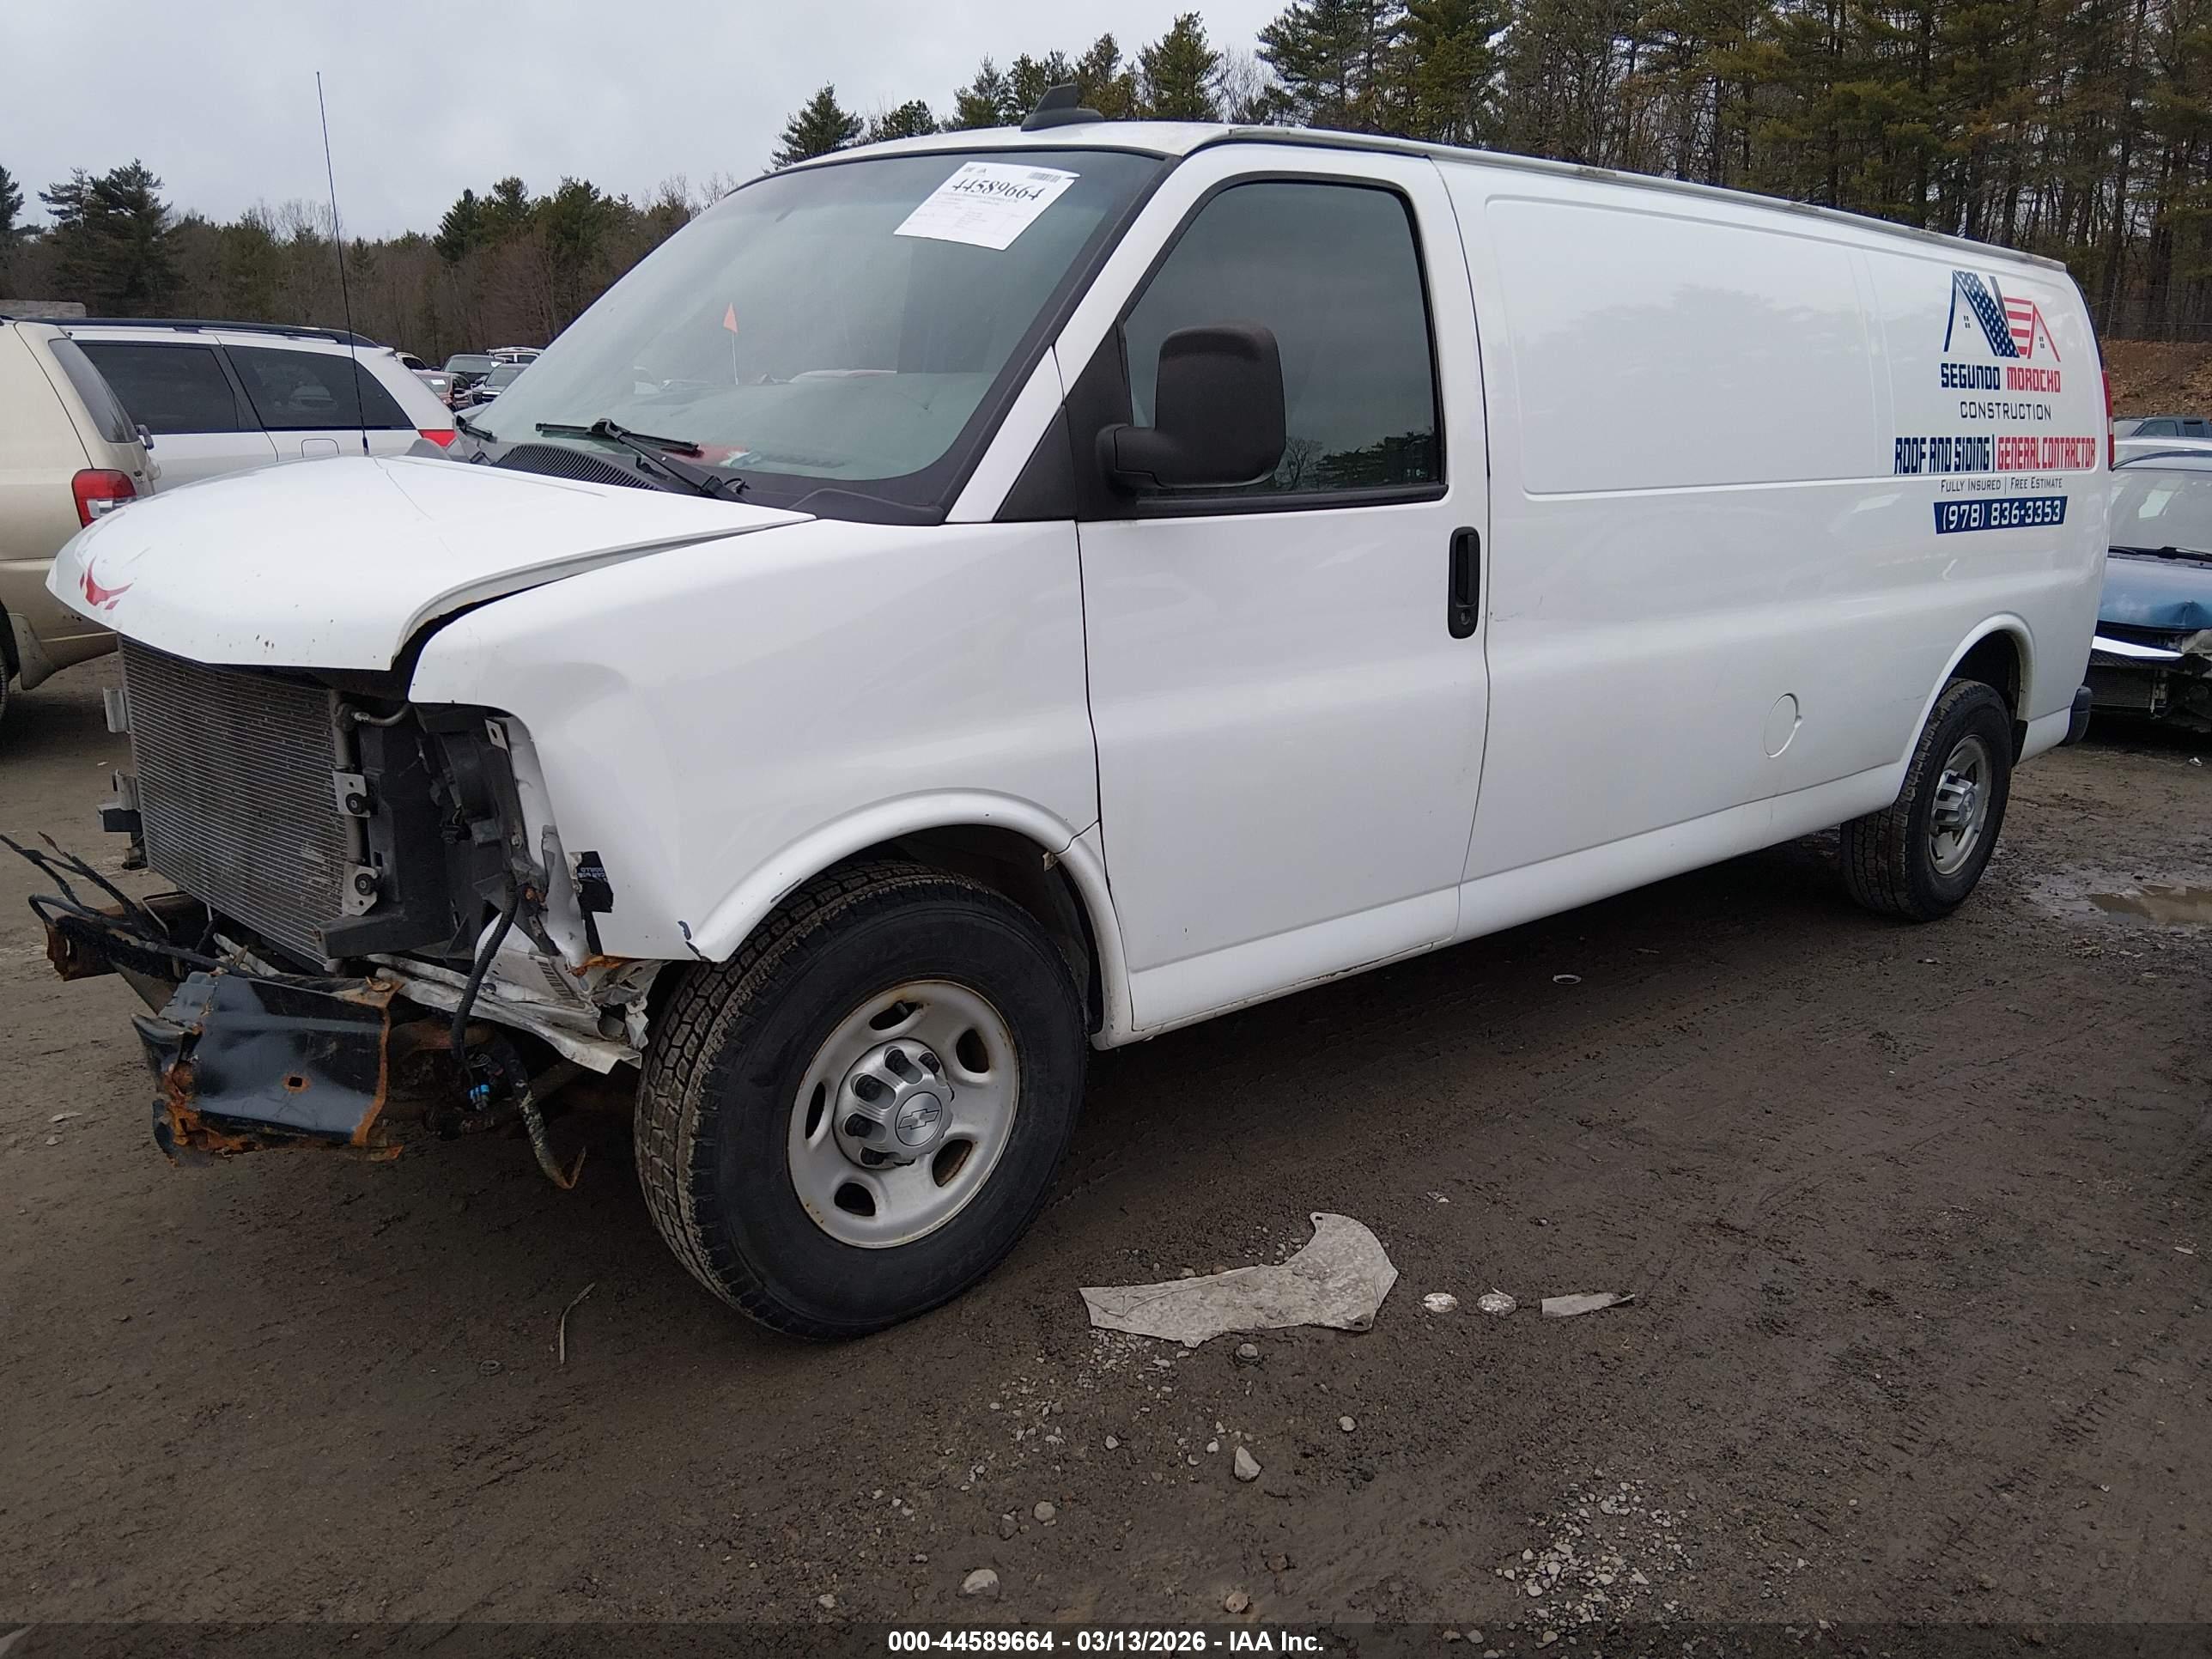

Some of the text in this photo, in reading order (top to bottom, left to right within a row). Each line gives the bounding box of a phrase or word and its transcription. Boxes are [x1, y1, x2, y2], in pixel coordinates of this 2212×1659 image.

[952, 179, 1046, 200] 44589664
[1941, 362, 2061, 392] SEGUNDO MOROCHO
[1960, 401, 2051, 420] CONSTRUCTION
[1894, 436, 2095, 474] ROOF AND SIDING GENERAL CONTRACTOR
[1943, 500, 2061, 531] (978) 836-3353
